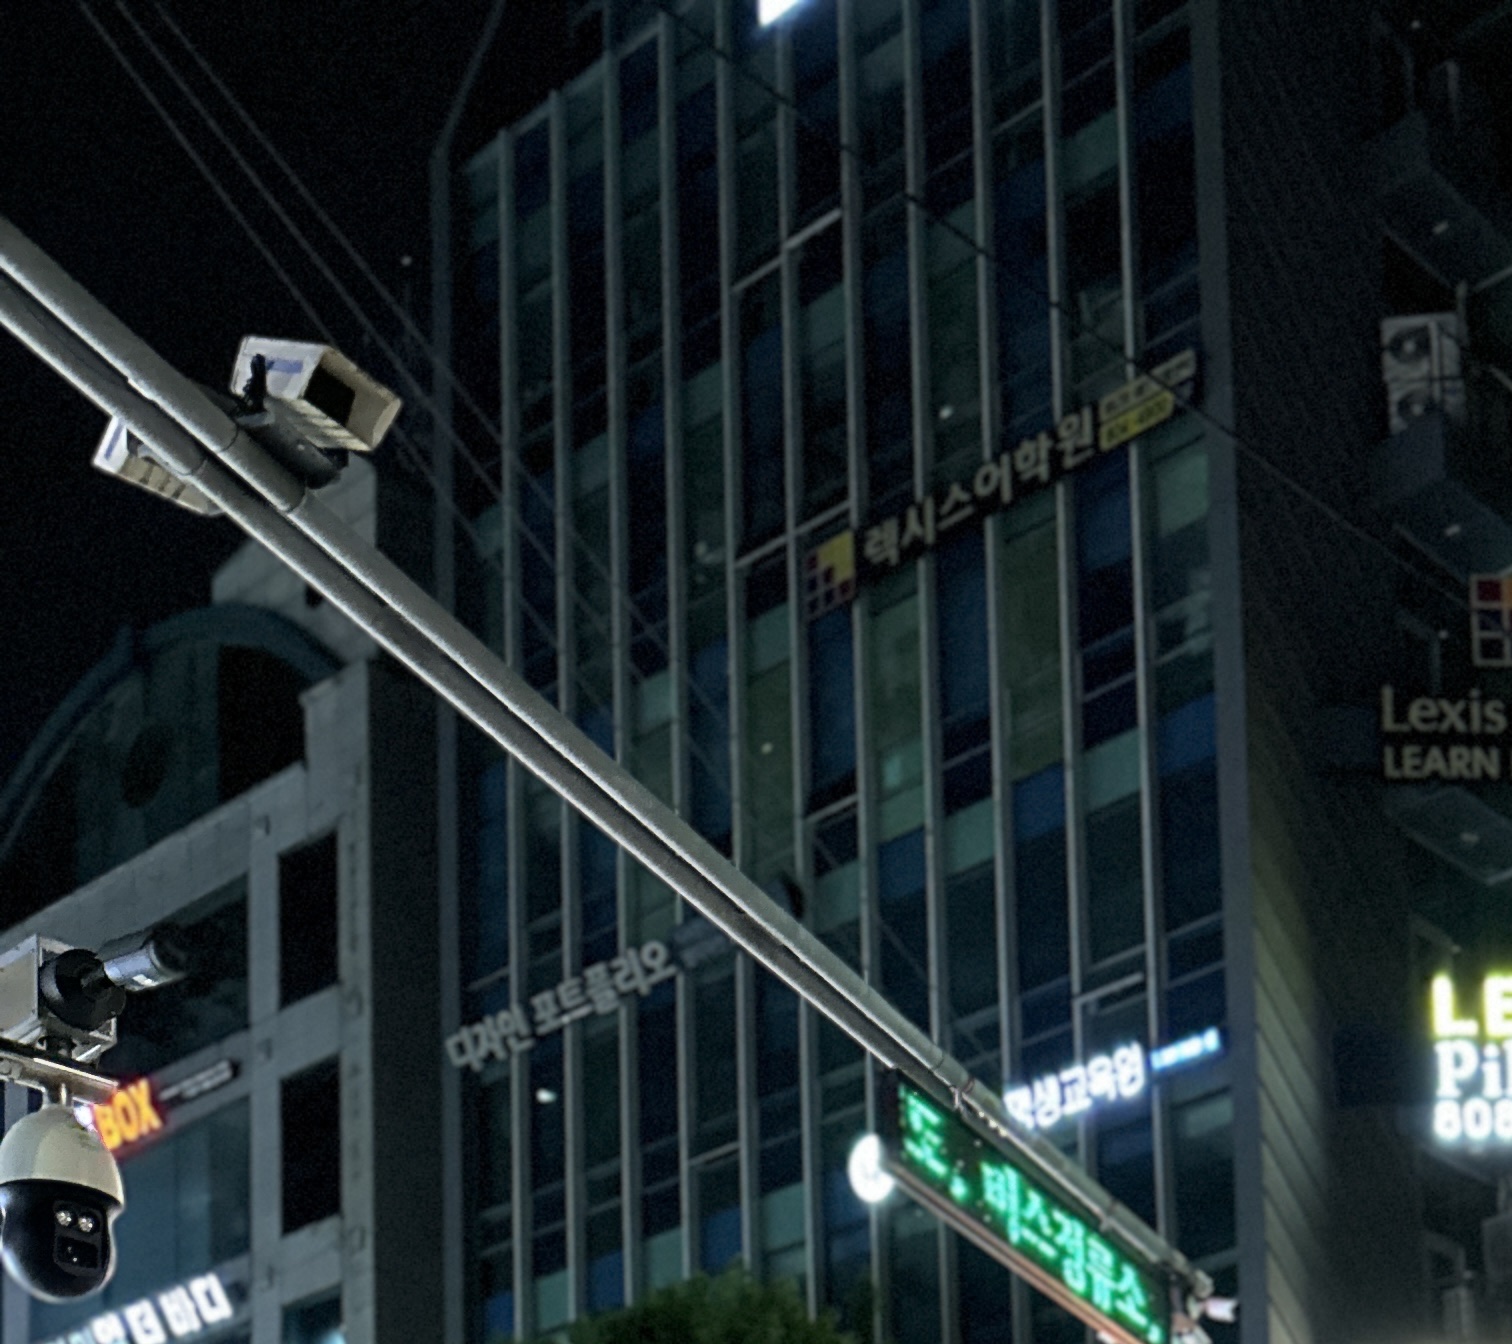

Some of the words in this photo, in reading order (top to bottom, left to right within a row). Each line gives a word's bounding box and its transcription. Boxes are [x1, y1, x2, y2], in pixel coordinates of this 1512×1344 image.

[862, 406, 1098, 566] 렉시스어학원
[1380, 684, 1507, 734] Lexis
[1383, 746, 1499, 780] LEARN
[445, 1010, 536, 1072] 디자인
[533, 936, 676, 1030] 포트폴리오
[94, 1077, 164, 1150] BOX
